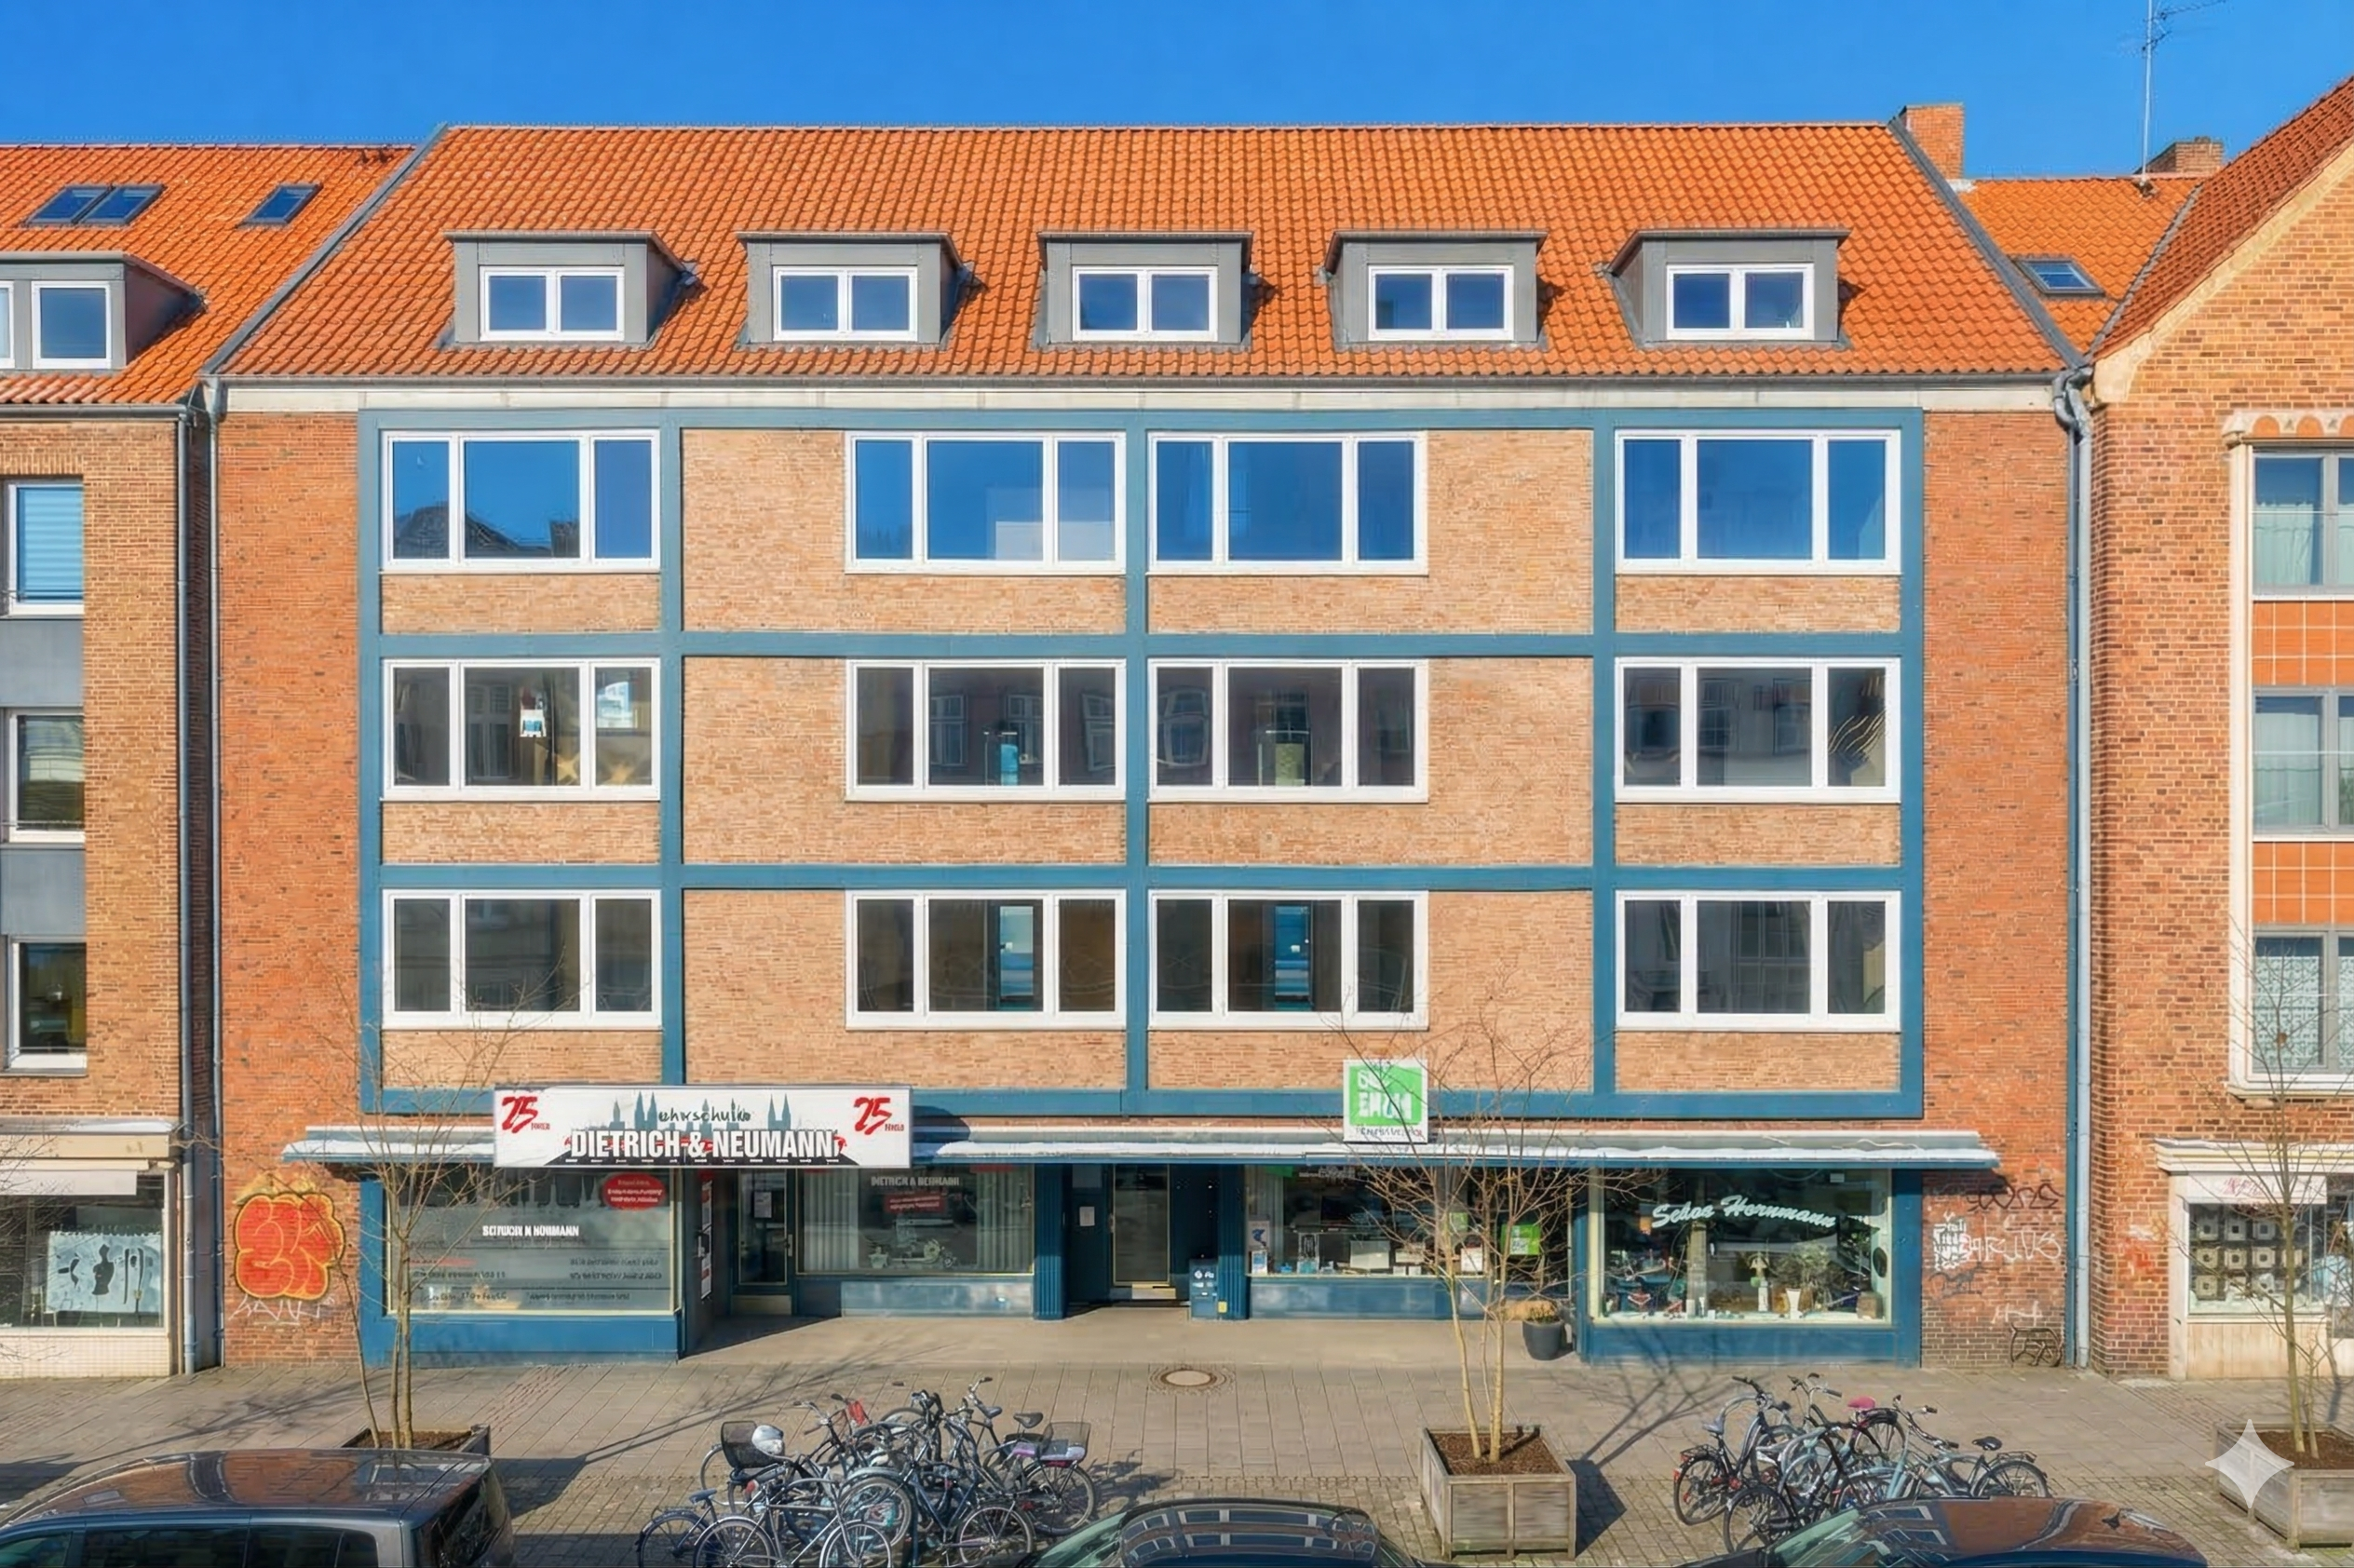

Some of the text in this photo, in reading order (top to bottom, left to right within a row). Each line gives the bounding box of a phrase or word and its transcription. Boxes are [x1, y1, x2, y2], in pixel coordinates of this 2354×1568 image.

[571, 1129, 832, 1158] DIETRICH & NEUMANN
